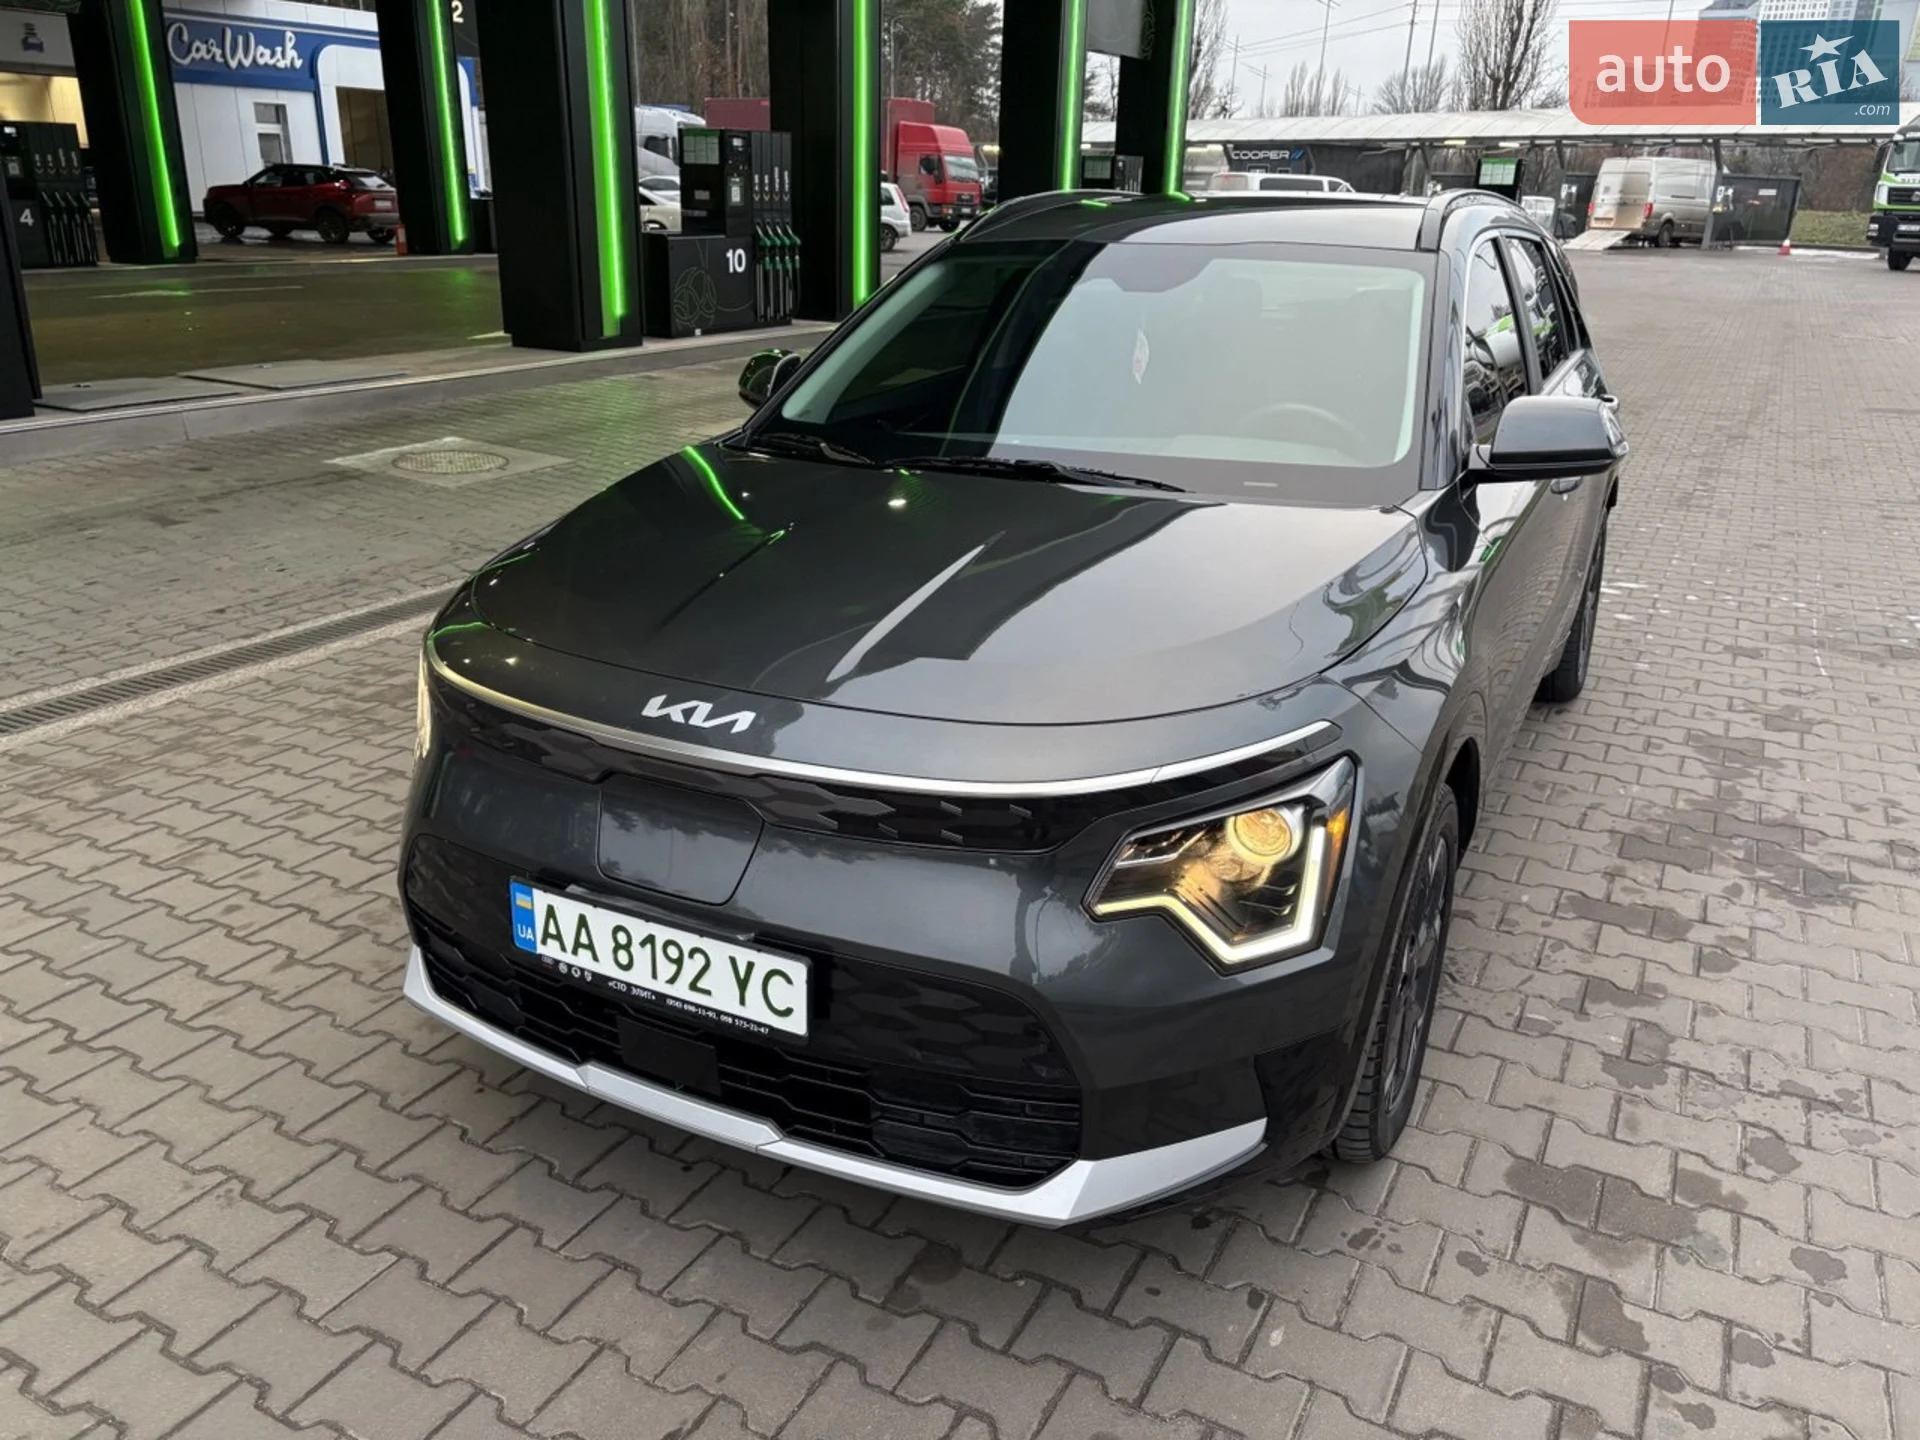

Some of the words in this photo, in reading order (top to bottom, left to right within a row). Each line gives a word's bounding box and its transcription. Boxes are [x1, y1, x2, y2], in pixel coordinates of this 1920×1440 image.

[1231, 150, 1290, 160] COOPER
[19, 208, 35, 226] 4
[726, 248, 747, 274] 10
[641, 694, 757, 734] KIA
[517, 923, 535, 942] UA
[540, 904, 600, 963] AA
[611, 924, 713, 997] 8192
[728, 955, 795, 1018] YC
